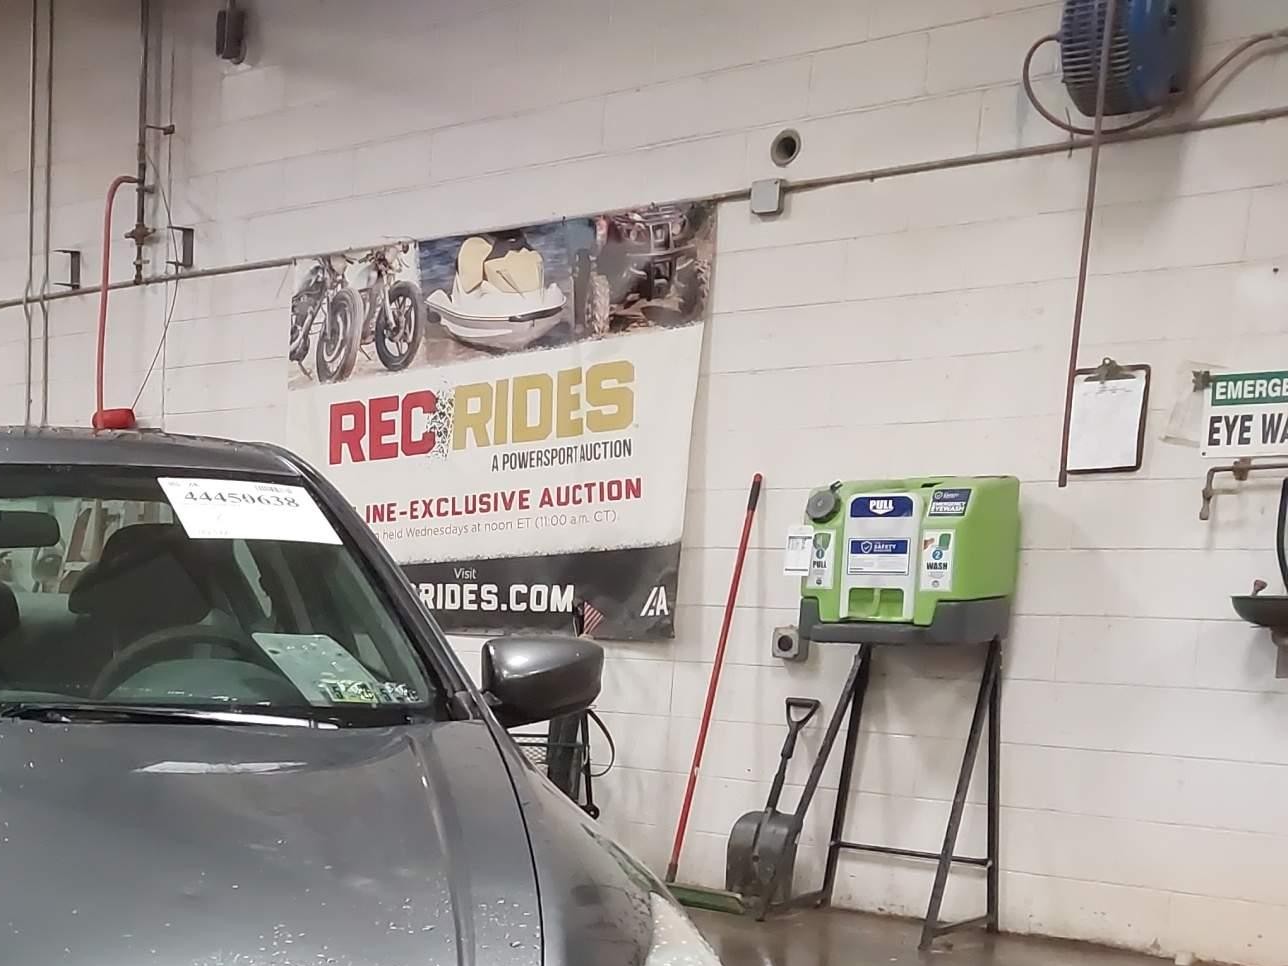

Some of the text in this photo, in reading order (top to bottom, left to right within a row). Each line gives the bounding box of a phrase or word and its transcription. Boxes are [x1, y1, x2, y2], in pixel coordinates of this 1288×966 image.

[329, 360, 636, 465] REC RIDES
[1208, 414, 1253, 446] EYE
[491, 438, 633, 472] A POWERSPORT AUCTION
[184, 491, 300, 508] 44450638
[352, 478, 642, 524] INE-EXCLUSIVE AUCTION
[869, 499, 894, 511] PULL
[383, 527, 403, 540] held
[406, 523, 469, 538] Wednesdays
[471, 522, 481, 532] at
[484, 520, 513, 533] noon
[517, 517, 532, 529] ET
[454, 567, 477, 580] Visit
[812, 560, 827, 569] PULL
[926, 562, 948, 570] WASH
[410, 583, 574, 612] RIDES.COM
